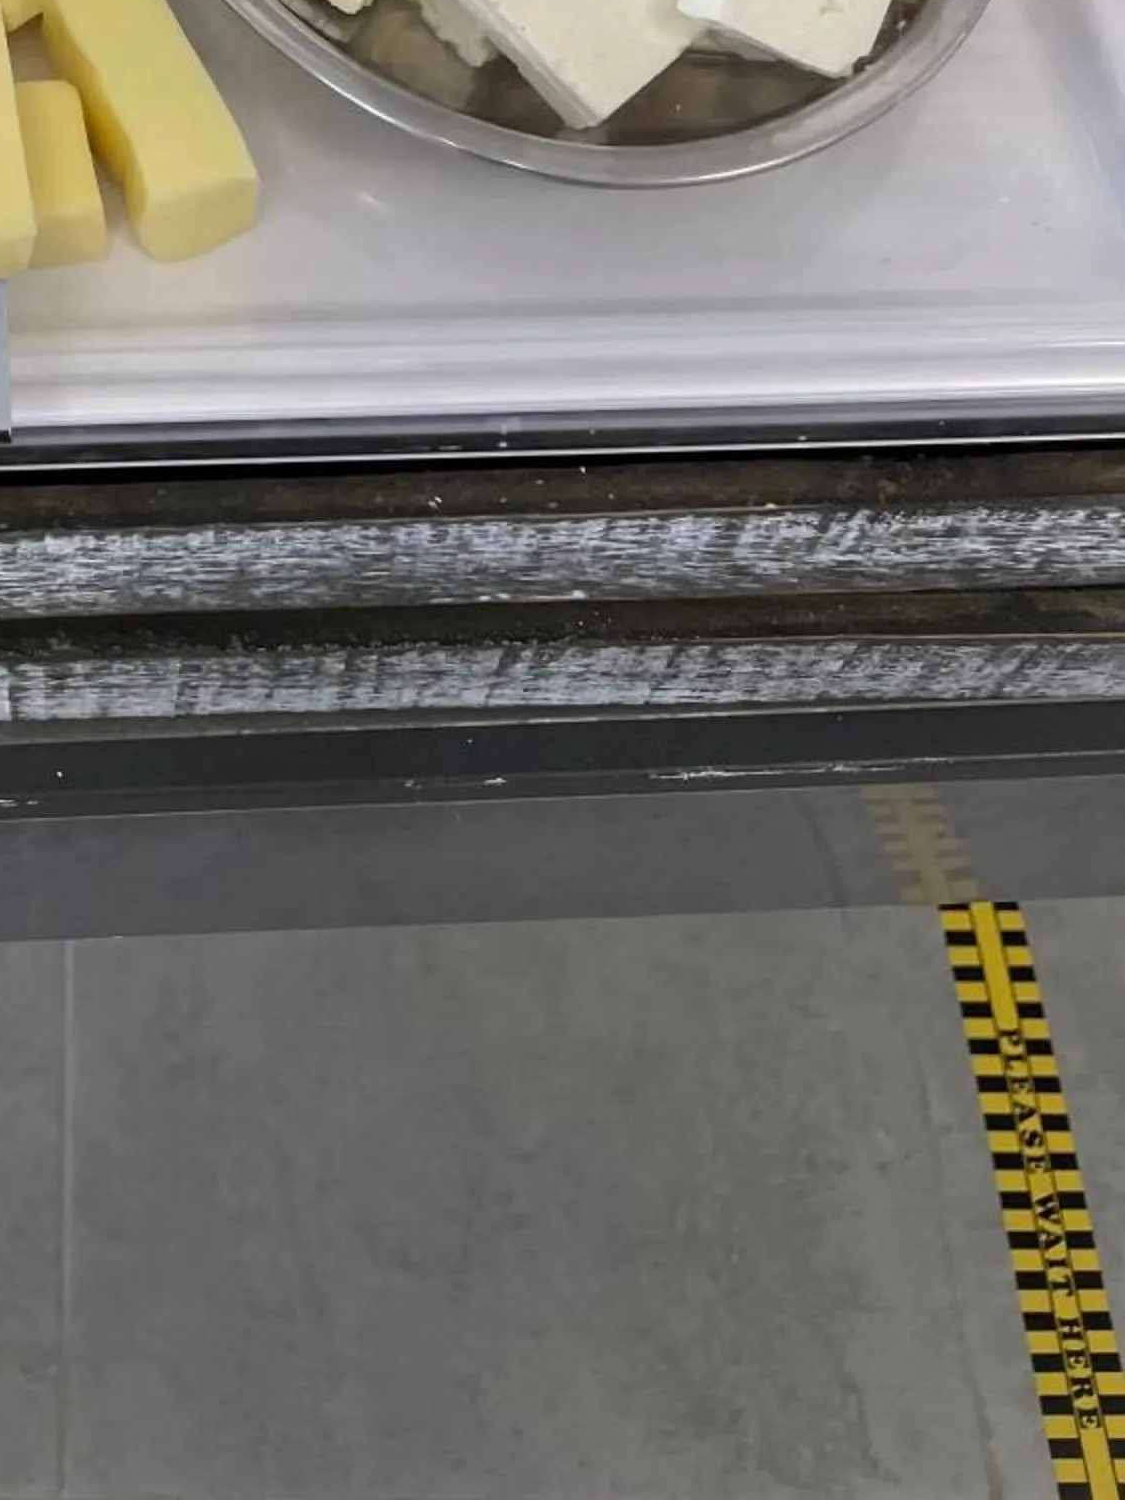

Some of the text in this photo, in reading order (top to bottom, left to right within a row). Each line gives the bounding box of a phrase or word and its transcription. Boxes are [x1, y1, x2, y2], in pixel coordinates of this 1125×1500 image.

[1000, 1029, 1102, 1429] PLEASE WAIT HERE
